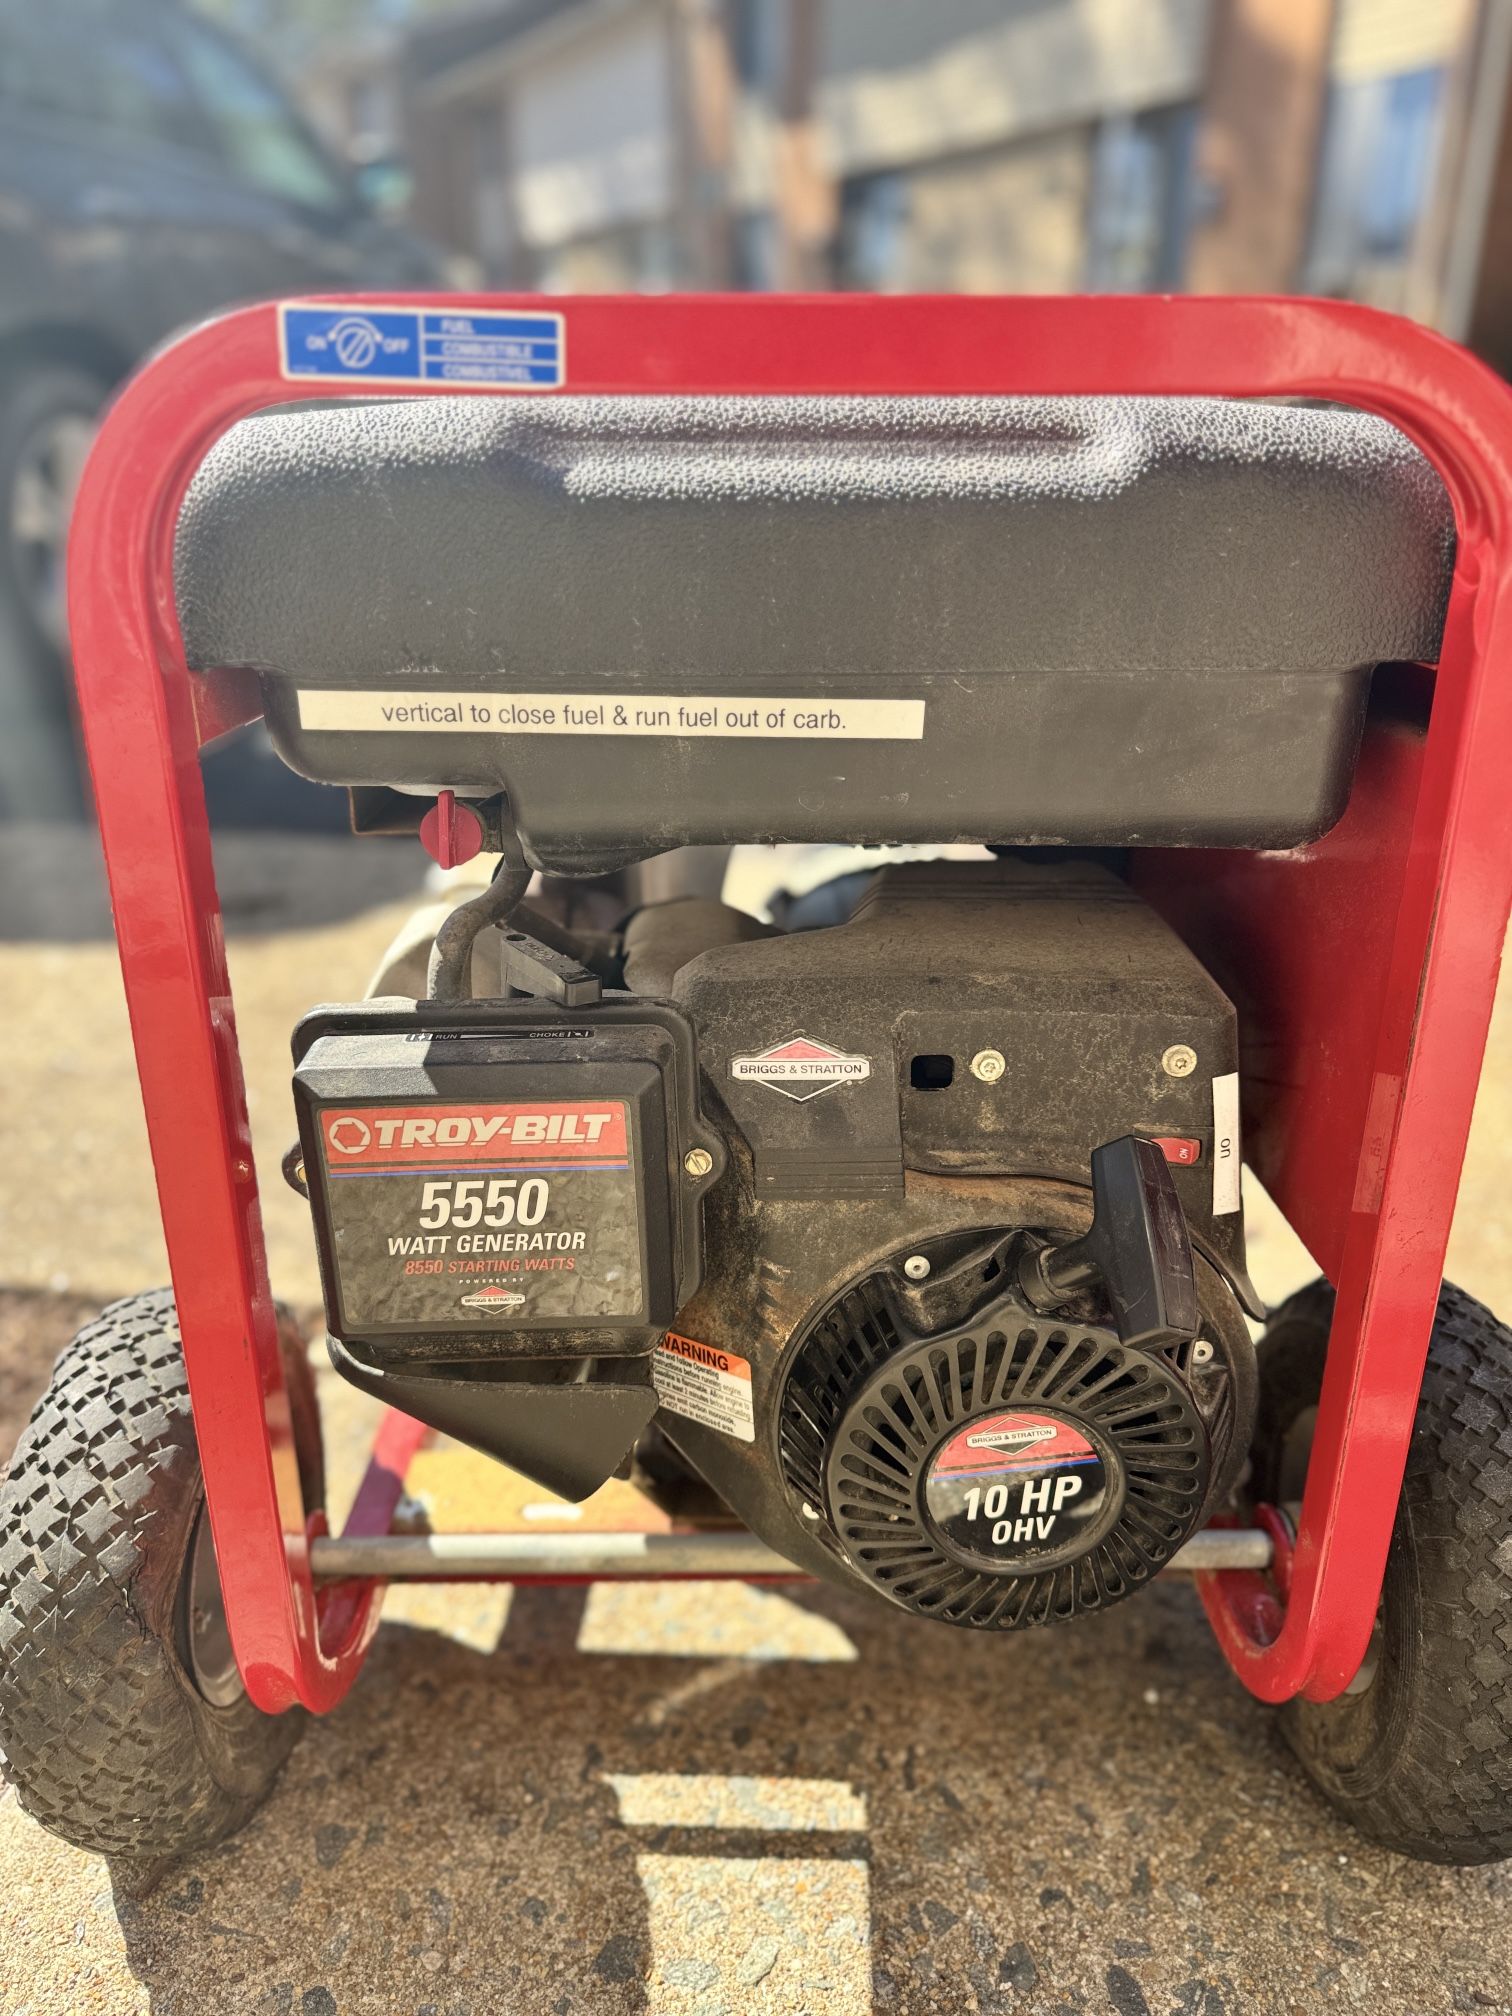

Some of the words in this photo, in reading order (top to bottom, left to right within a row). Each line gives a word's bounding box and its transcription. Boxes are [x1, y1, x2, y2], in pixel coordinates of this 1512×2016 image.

[442, 320, 472, 334] FUEL
[306, 334, 327, 351] ON
[382, 338, 409, 354] OFF
[382, 704, 463, 724] vertical
[471, 707, 490, 724] to
[499, 704, 555, 725] close
[563, 705, 604, 725] fuel
[613, 707, 629, 726] &
[636, 711, 670, 726] run
[678, 706, 717, 728] fuel
[726, 710, 758, 728] out
[766, 707, 786, 728] of
[793, 708, 846, 730] carb.
[740, 1065, 785, 1073] BRIGGS
[790, 1065, 797, 1073] &
[801, 1065, 861, 1073] STRATTON
[374, 1113, 611, 1149] TROY-BILT
[1220, 1138, 1230, 1159] on
[419, 1178, 549, 1229] 5550
[388, 1235, 451, 1256] WATT
[457, 1231, 585, 1253] GENERATOR
[405, 1259, 443, 1275] 8550
[448, 1259, 519, 1274] STARTING
[525, 1257, 575, 1272] WATTS
[972, 1433, 1002, 1443] BRIGGS
[1011, 1429, 1052, 1439] STRATTON
[964, 1484, 1008, 1521] 10
[1020, 1475, 1082, 1514] HP
[992, 1515, 1055, 1545] OHV
